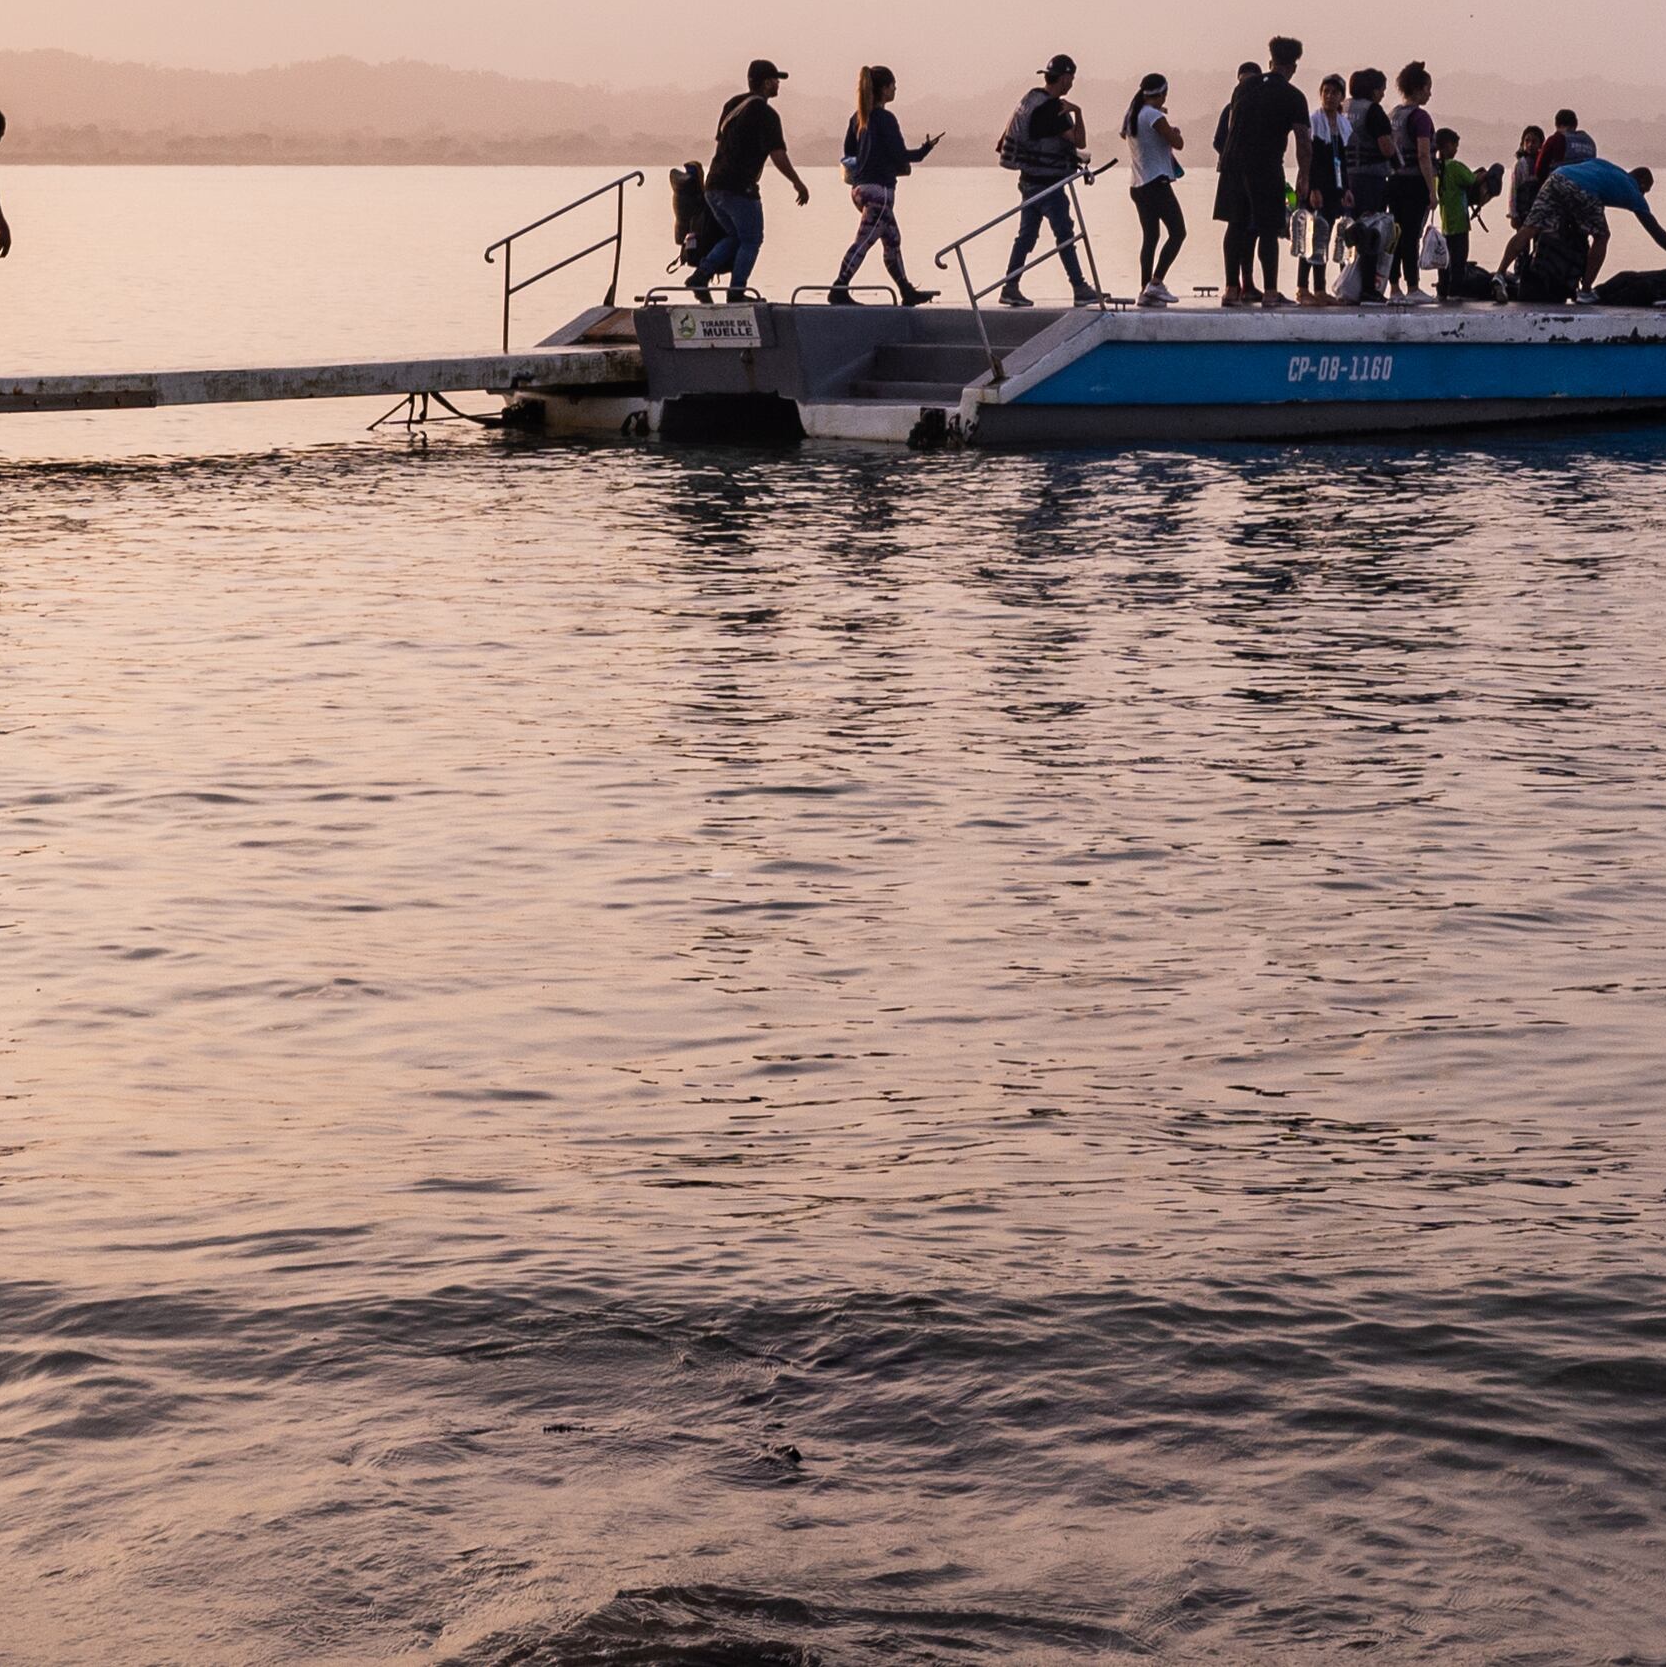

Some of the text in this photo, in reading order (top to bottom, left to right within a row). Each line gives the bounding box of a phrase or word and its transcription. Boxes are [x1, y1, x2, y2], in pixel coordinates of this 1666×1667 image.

[700, 320, 736, 328] TIRARSE
[702, 327, 753, 337] MUELLE
[1288, 355, 1393, 382] CP-08-1160
